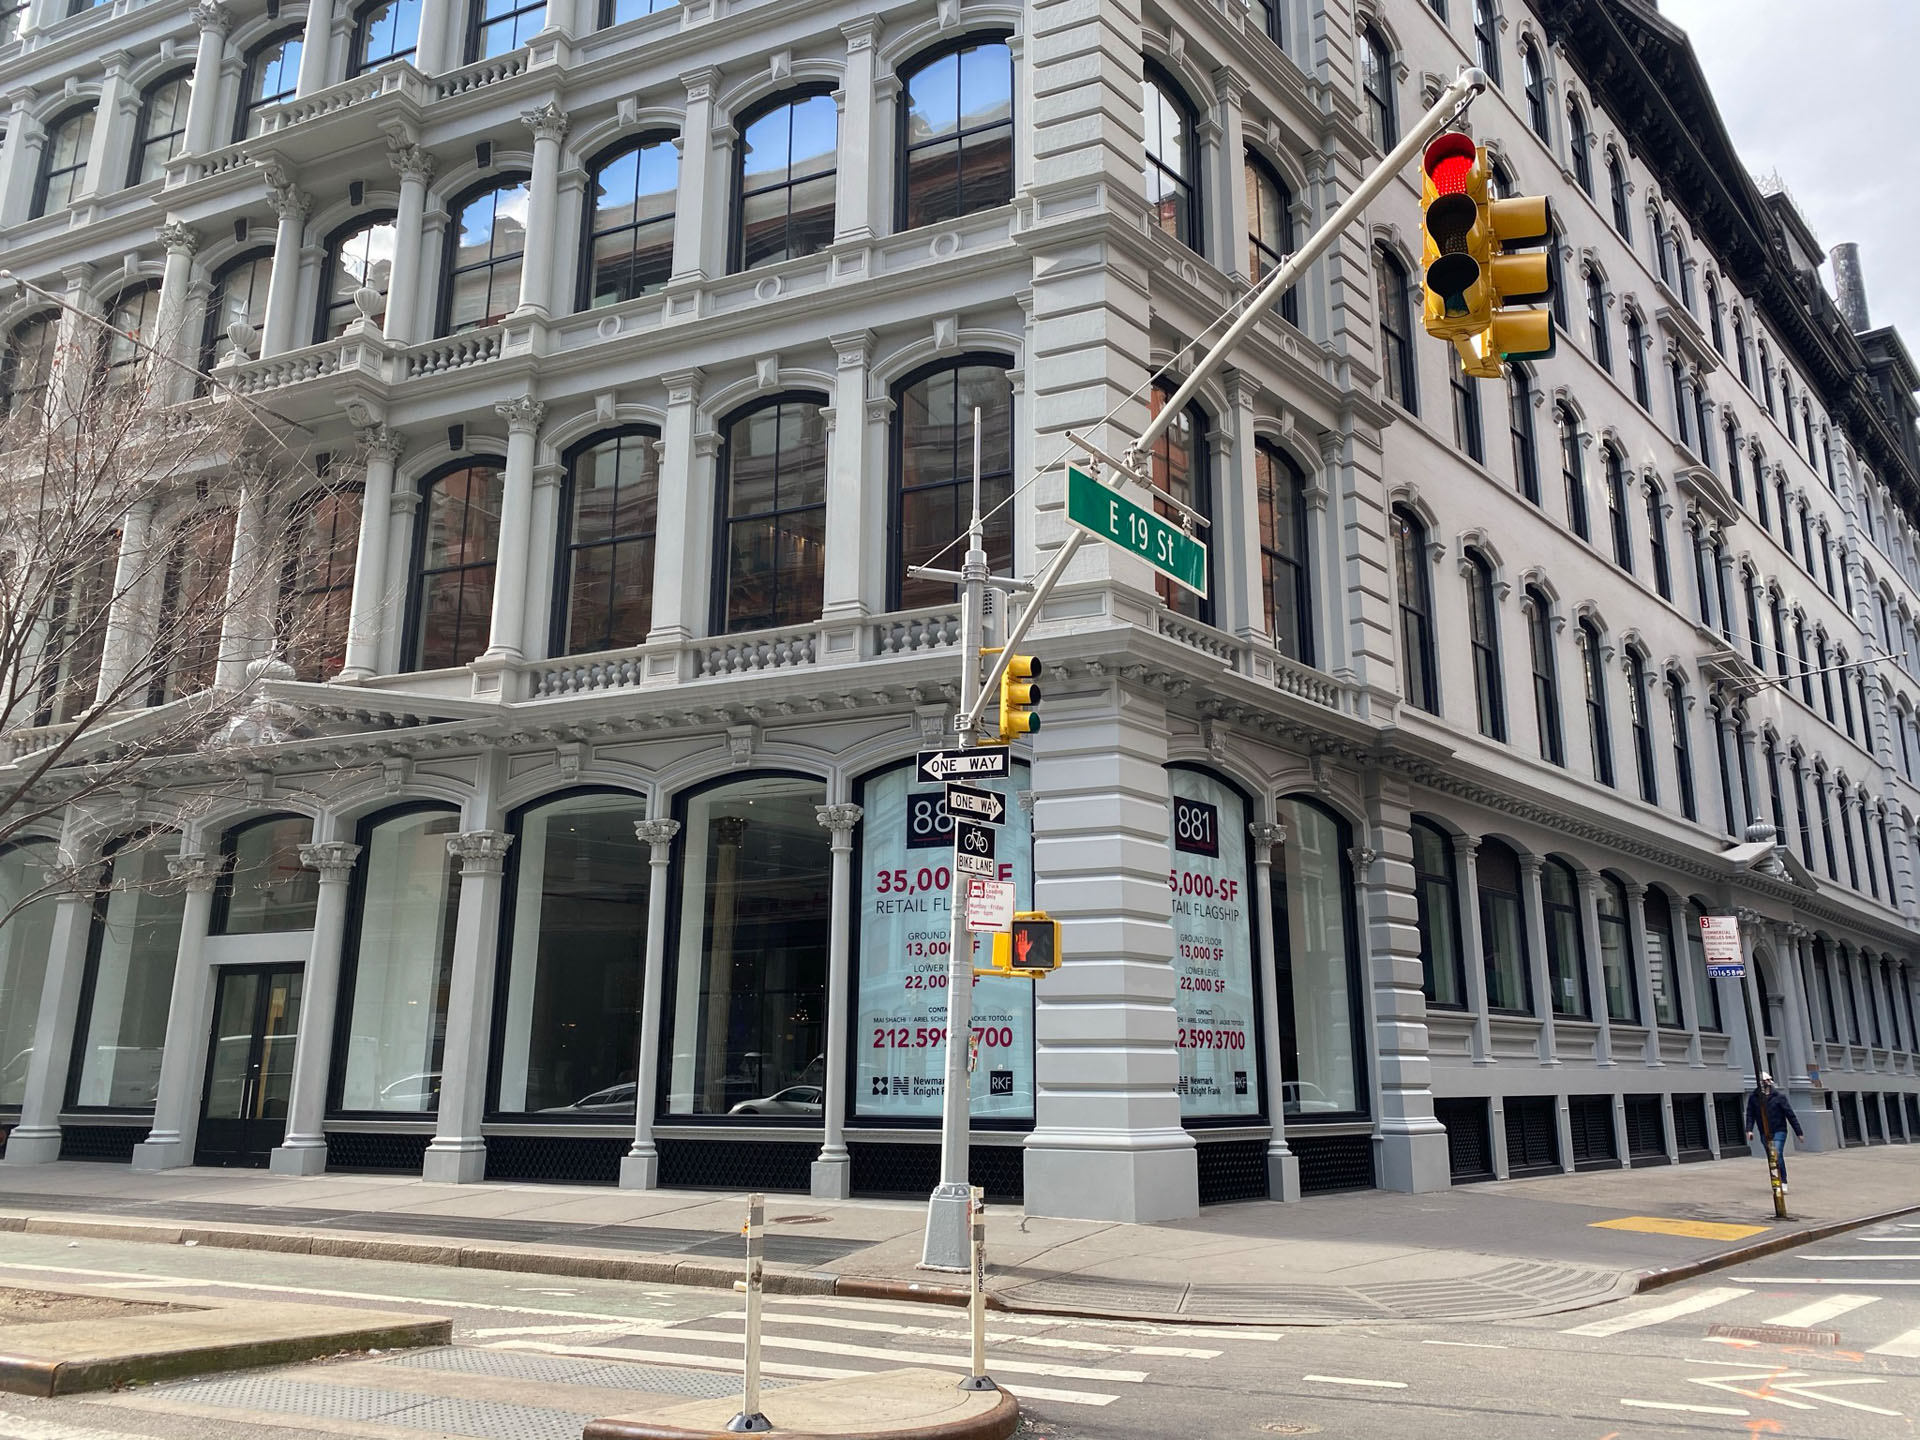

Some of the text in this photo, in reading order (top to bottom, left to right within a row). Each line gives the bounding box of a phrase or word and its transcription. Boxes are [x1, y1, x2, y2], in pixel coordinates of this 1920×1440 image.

[1110, 500, 1174, 567] E 19 St
[931, 756, 997, 773] ONE WAY
[955, 794, 998, 814] ONE WAY
[913, 799, 954, 834] 88
[1178, 804, 1210, 843] 881
[958, 855, 993, 873] BIKE LANE
[1169, 869, 1238, 902] 5,000-SF
[876, 898, 927, 914] RETAIL
[1172, 899, 1240, 922] TAIL FLAGSHIP
[1702, 918, 1709, 928] 3
[907, 930, 946, 940] GROUND
[1180, 933, 1222, 946] GROUND FLOOR
[906, 941, 950, 957] 13,00
[1179, 944, 1224, 961] 13,000 SF
[913, 963, 944, 973] LOWER
[1185, 966, 1220, 977] LOWER LEVEL
[905, 974, 949, 991] 22,00
[1180, 976, 1225, 993] 22,000 SF
[1175, 1027, 1245, 1050] 2.599.3700
[913, 1076, 945, 1086] Newmar
[992, 1076, 1012, 1090] RKF
[913, 1086, 940, 1097] Knight
